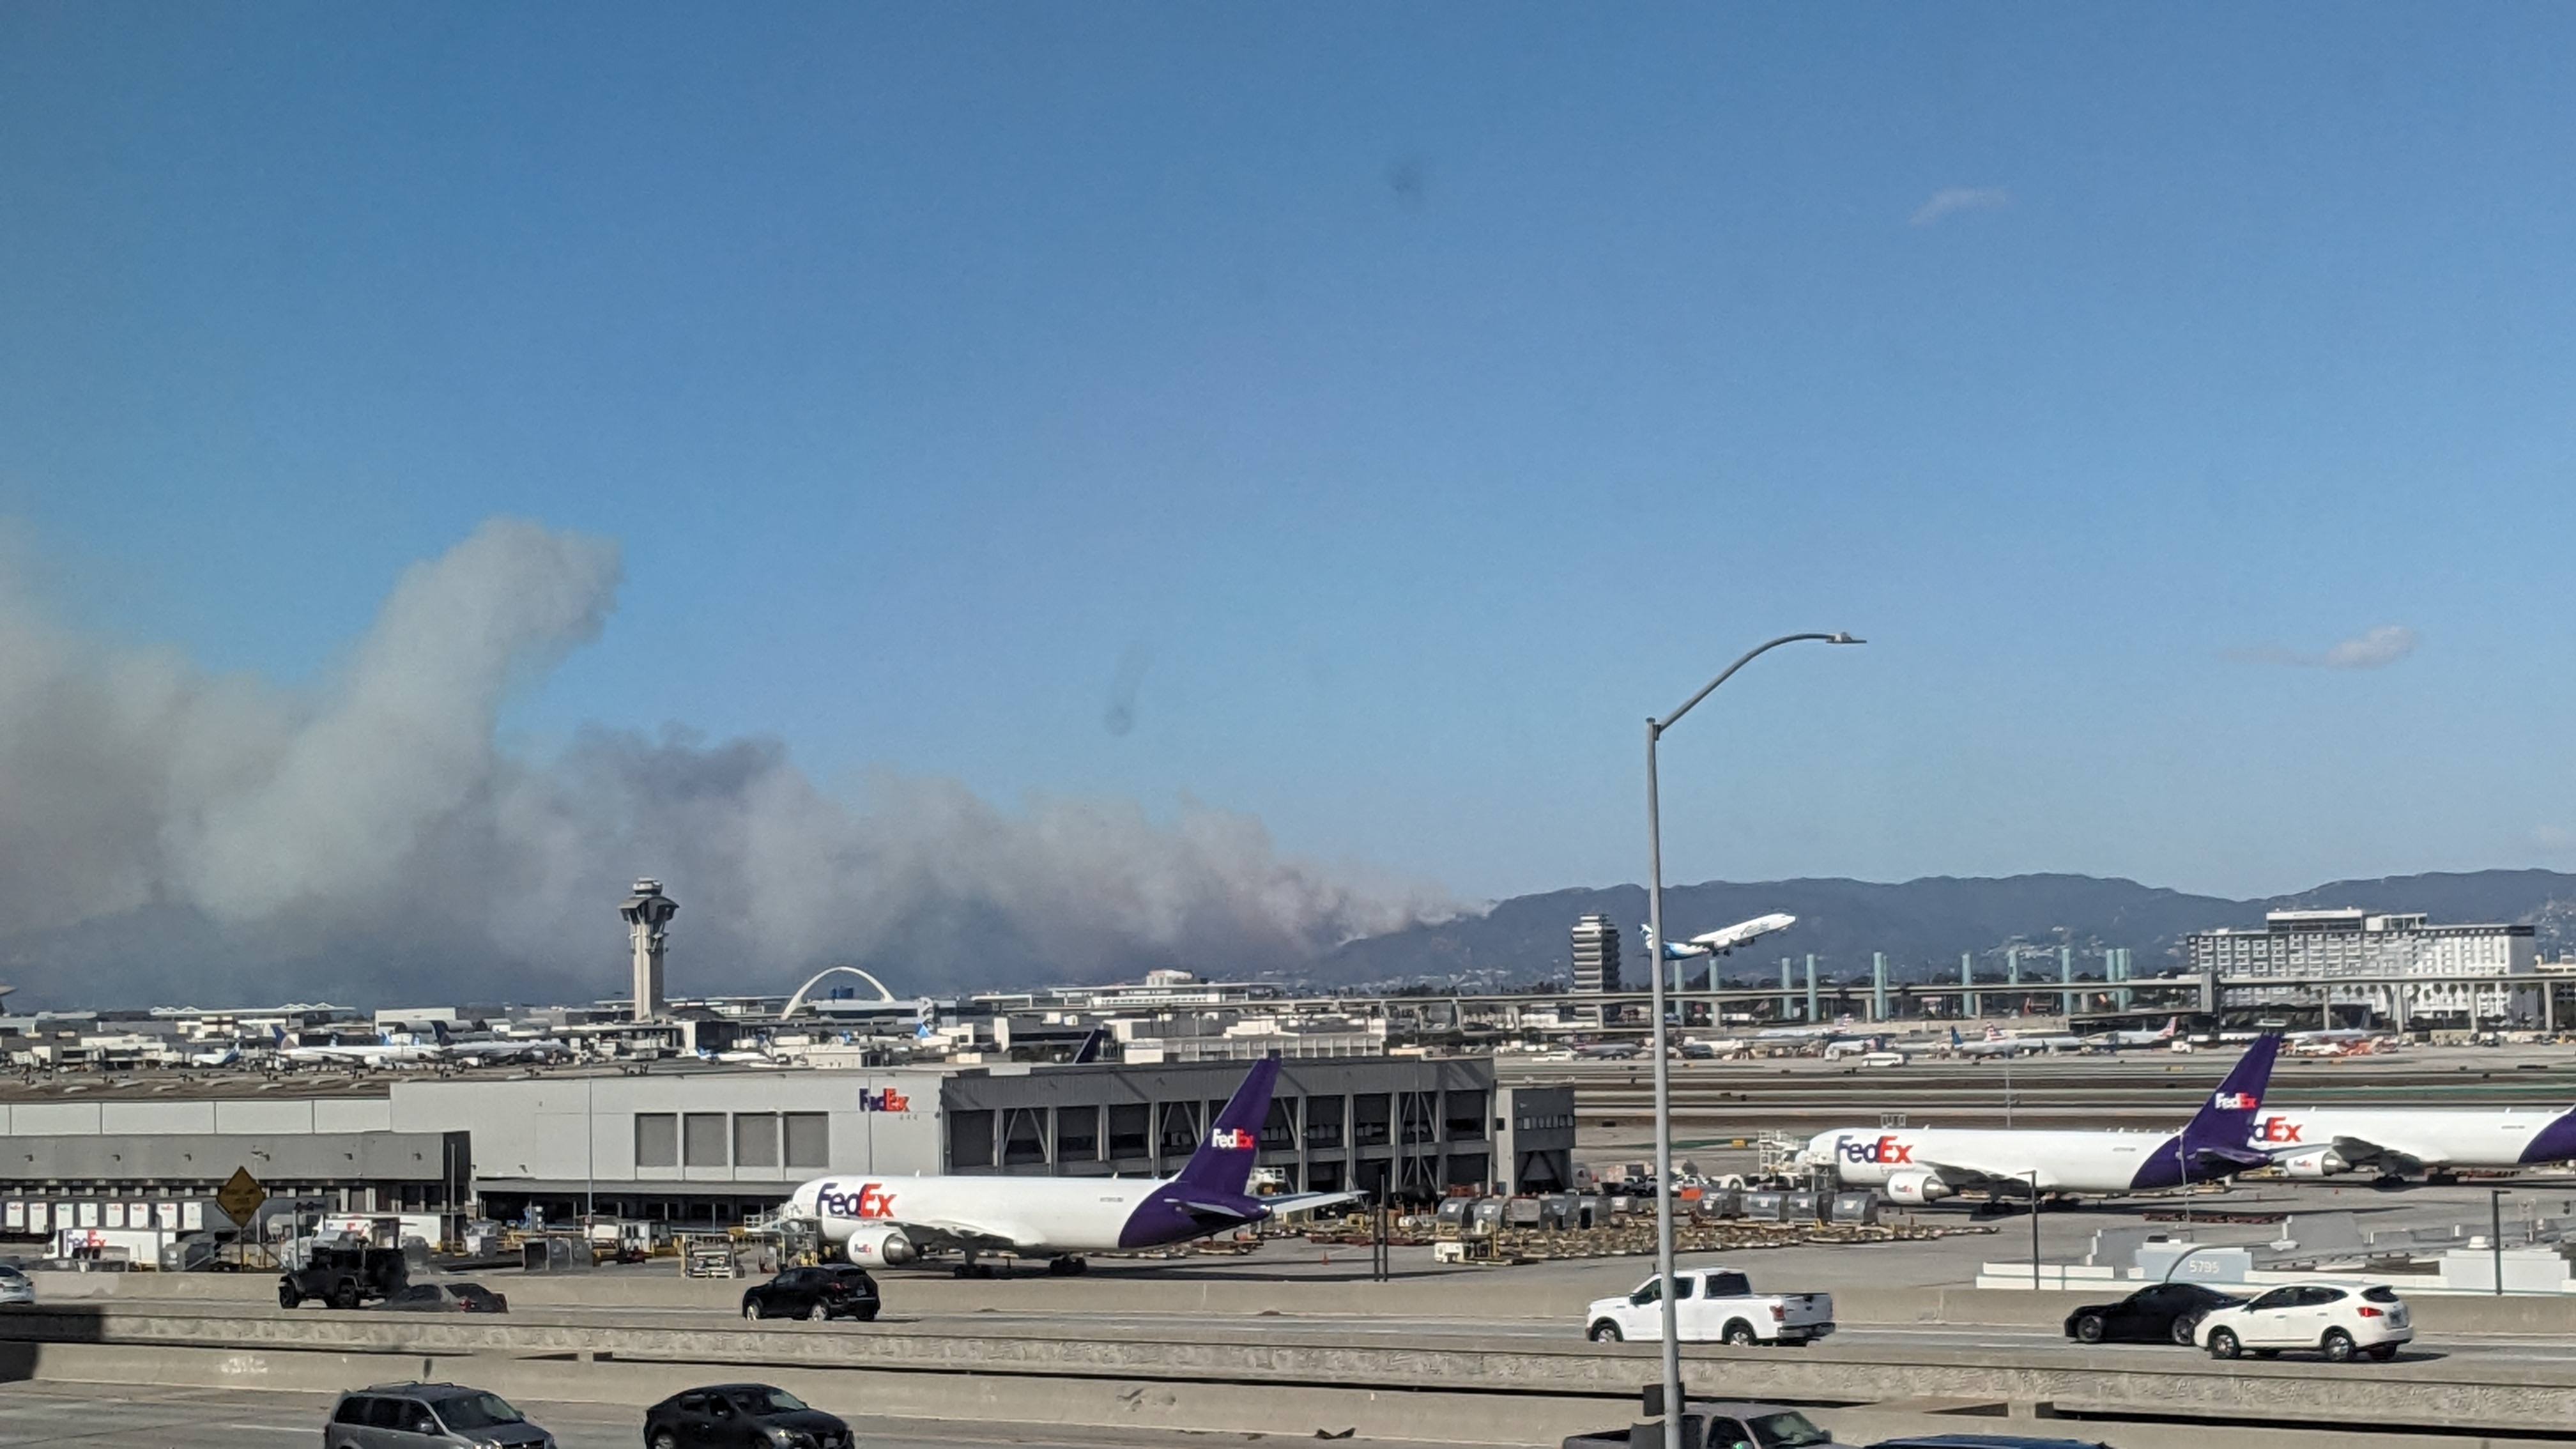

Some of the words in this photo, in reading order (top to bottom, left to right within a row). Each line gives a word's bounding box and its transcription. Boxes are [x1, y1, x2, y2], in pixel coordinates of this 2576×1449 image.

[859, 1088, 910, 1112] FedEx
[2215, 1093, 2257, 1109] FedEx
[1212, 1128, 1254, 1149] FedEx
[2252, 1117, 2303, 1142] dEx
[1835, 1135, 1913, 1163] FedEx
[816, 1183, 897, 1217] FedEx
